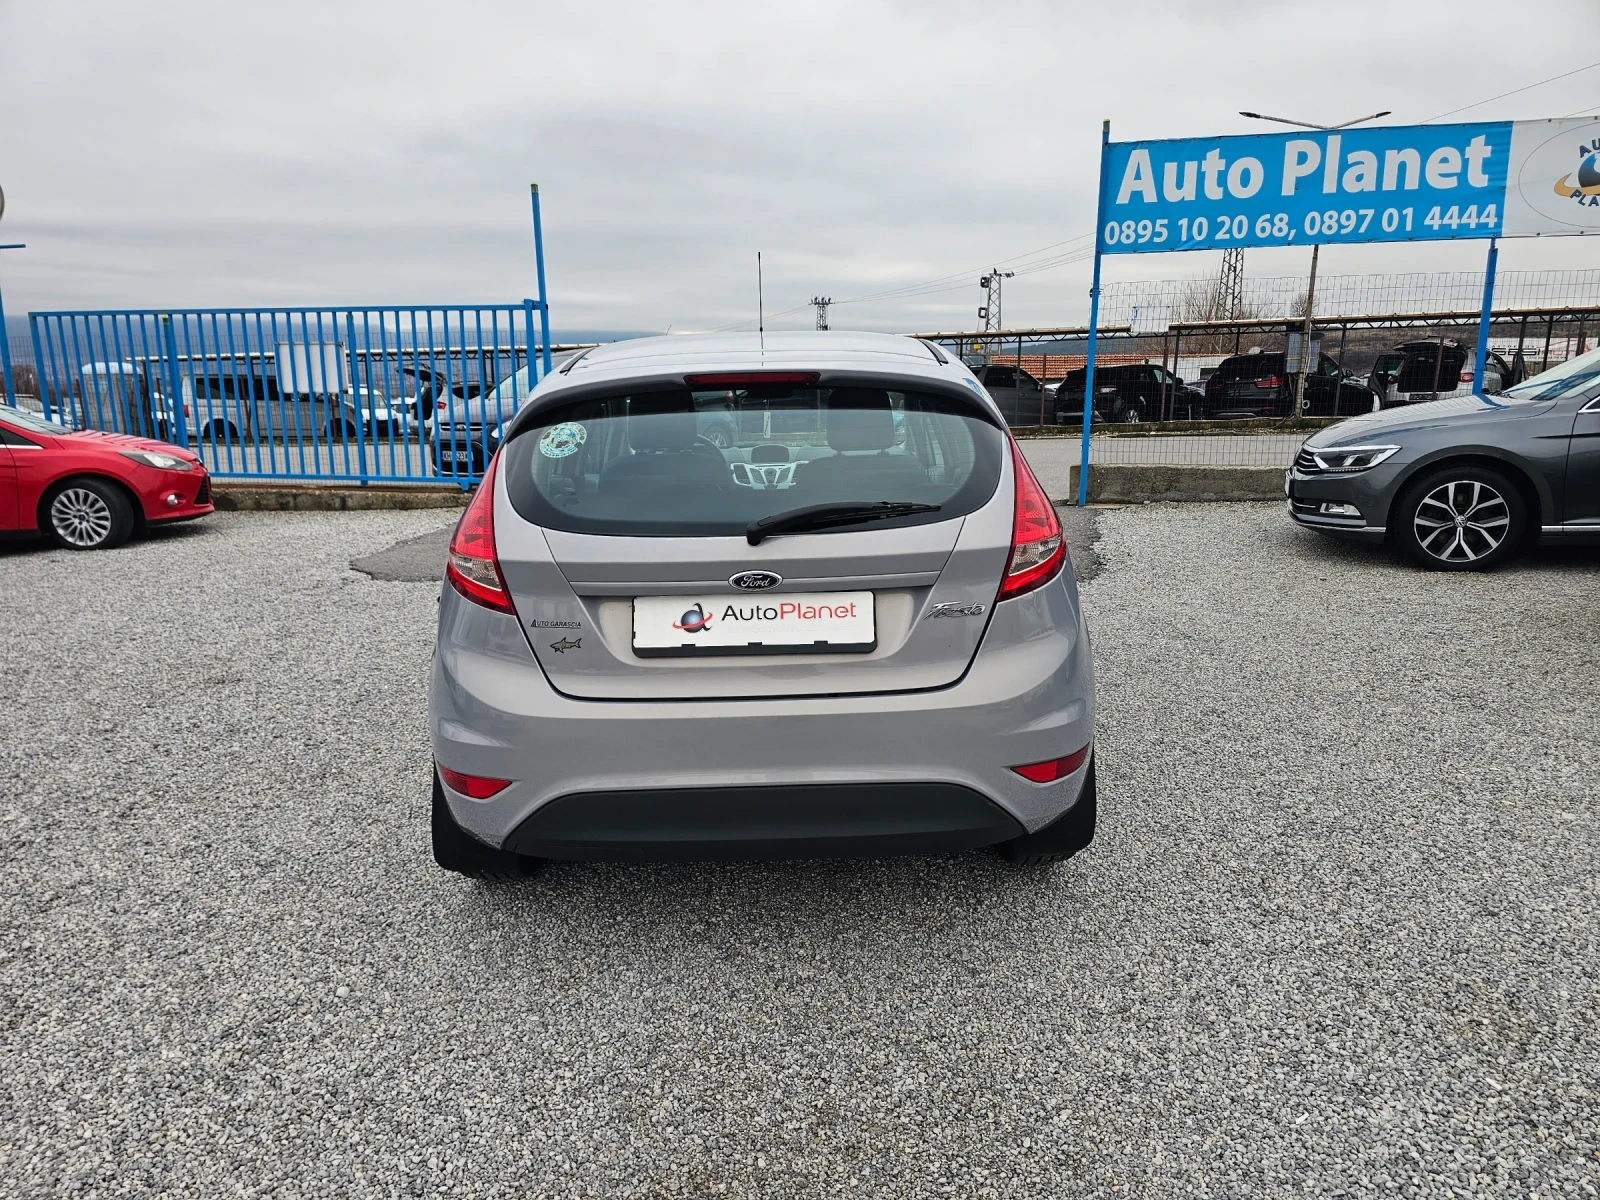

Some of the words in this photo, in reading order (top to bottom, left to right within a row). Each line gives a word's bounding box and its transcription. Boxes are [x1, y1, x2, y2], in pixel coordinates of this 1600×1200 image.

[1579, 138, 1600, 158] AU
[1115, 148, 1264, 205] Auto
[1281, 134, 1492, 196] Planet
[1570, 189, 1600, 207] PLA
[1104, 219, 1168, 245] 0895
[1178, 217, 1208, 241] 10
[1215, 215, 1249, 240] 20
[1255, 213, 1296, 241] 68,
[1304, 209, 1375, 236] 0897
[1381, 207, 1413, 232] 01
[1424, 204, 1498, 230] 4444
[740, 574, 770, 587] Ford
[721, 602, 857, 621] AutoPlanet
[923, 601, 985, 620] Fiesta
[530, 619, 549, 627] AUTO
